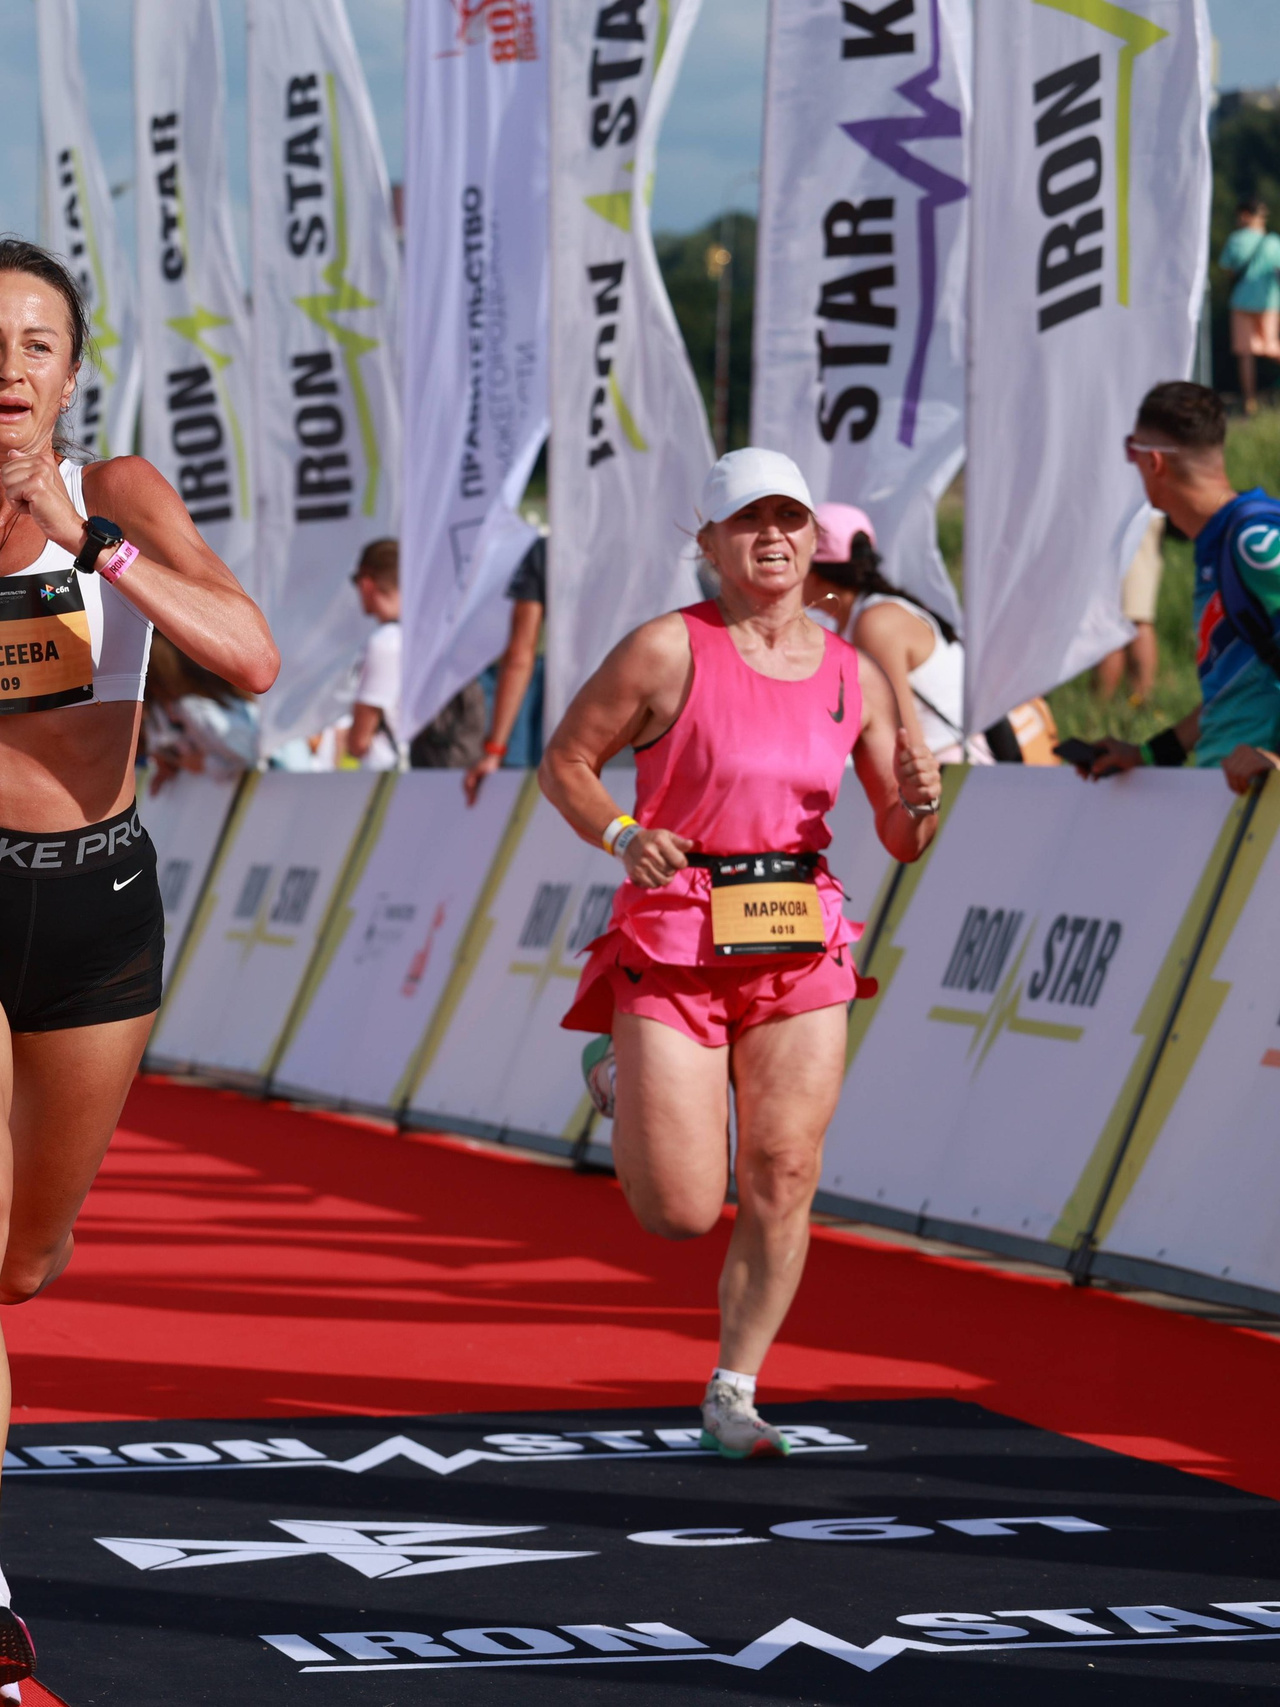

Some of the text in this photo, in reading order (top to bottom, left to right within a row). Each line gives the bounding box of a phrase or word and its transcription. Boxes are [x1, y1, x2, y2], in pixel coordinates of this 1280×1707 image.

[1034, 53, 1105, 334] IRON
[284, 73, 352, 524] IRON STAR
[815, 198, 897, 444] STAR
[167, 365, 233, 525] IRON
[744, 900, 808, 917] МАРКОВА
[770, 925, 795, 935] 4018
[941, 905, 1122, 1008] IRON STAR
[259, 1622, 710, 1661] IRON
